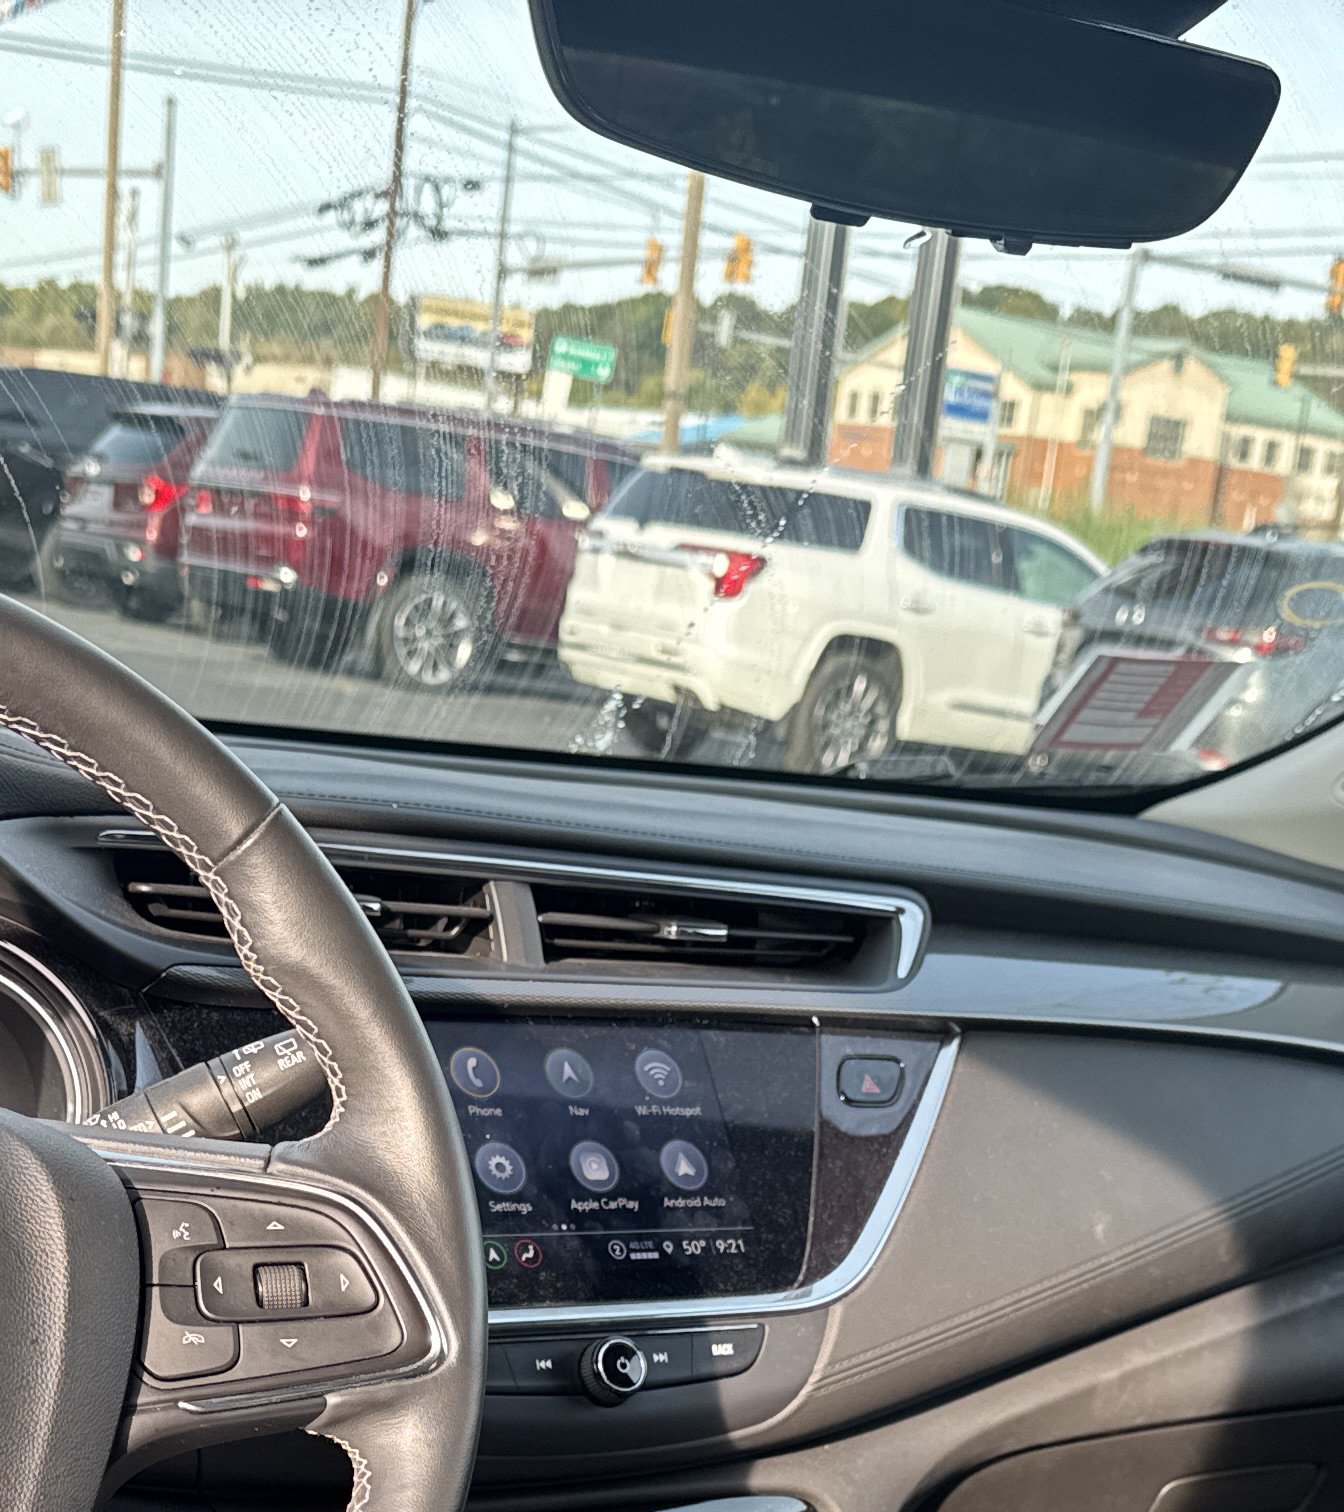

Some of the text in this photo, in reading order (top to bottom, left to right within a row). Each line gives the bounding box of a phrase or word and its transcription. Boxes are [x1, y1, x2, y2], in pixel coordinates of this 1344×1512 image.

[277, 1052, 307, 1071] REAR
[232, 1062, 252, 1078] OFF
[238, 1075, 257, 1091] INT
[246, 1087, 263, 1103] ON
[468, 1105, 503, 1117] Phone
[569, 1106, 589, 1116] Nav
[635, 1105, 702, 1117] Wi-Fi Hotspot
[489, 1201, 532, 1214] Settings
[570, 1199, 639, 1212] Apple CarPlay
[663, 1197, 726, 1208] Android Auto
[716, 1239, 745, 1254] 9:21
[711, 1343, 734, 1356] BACK
